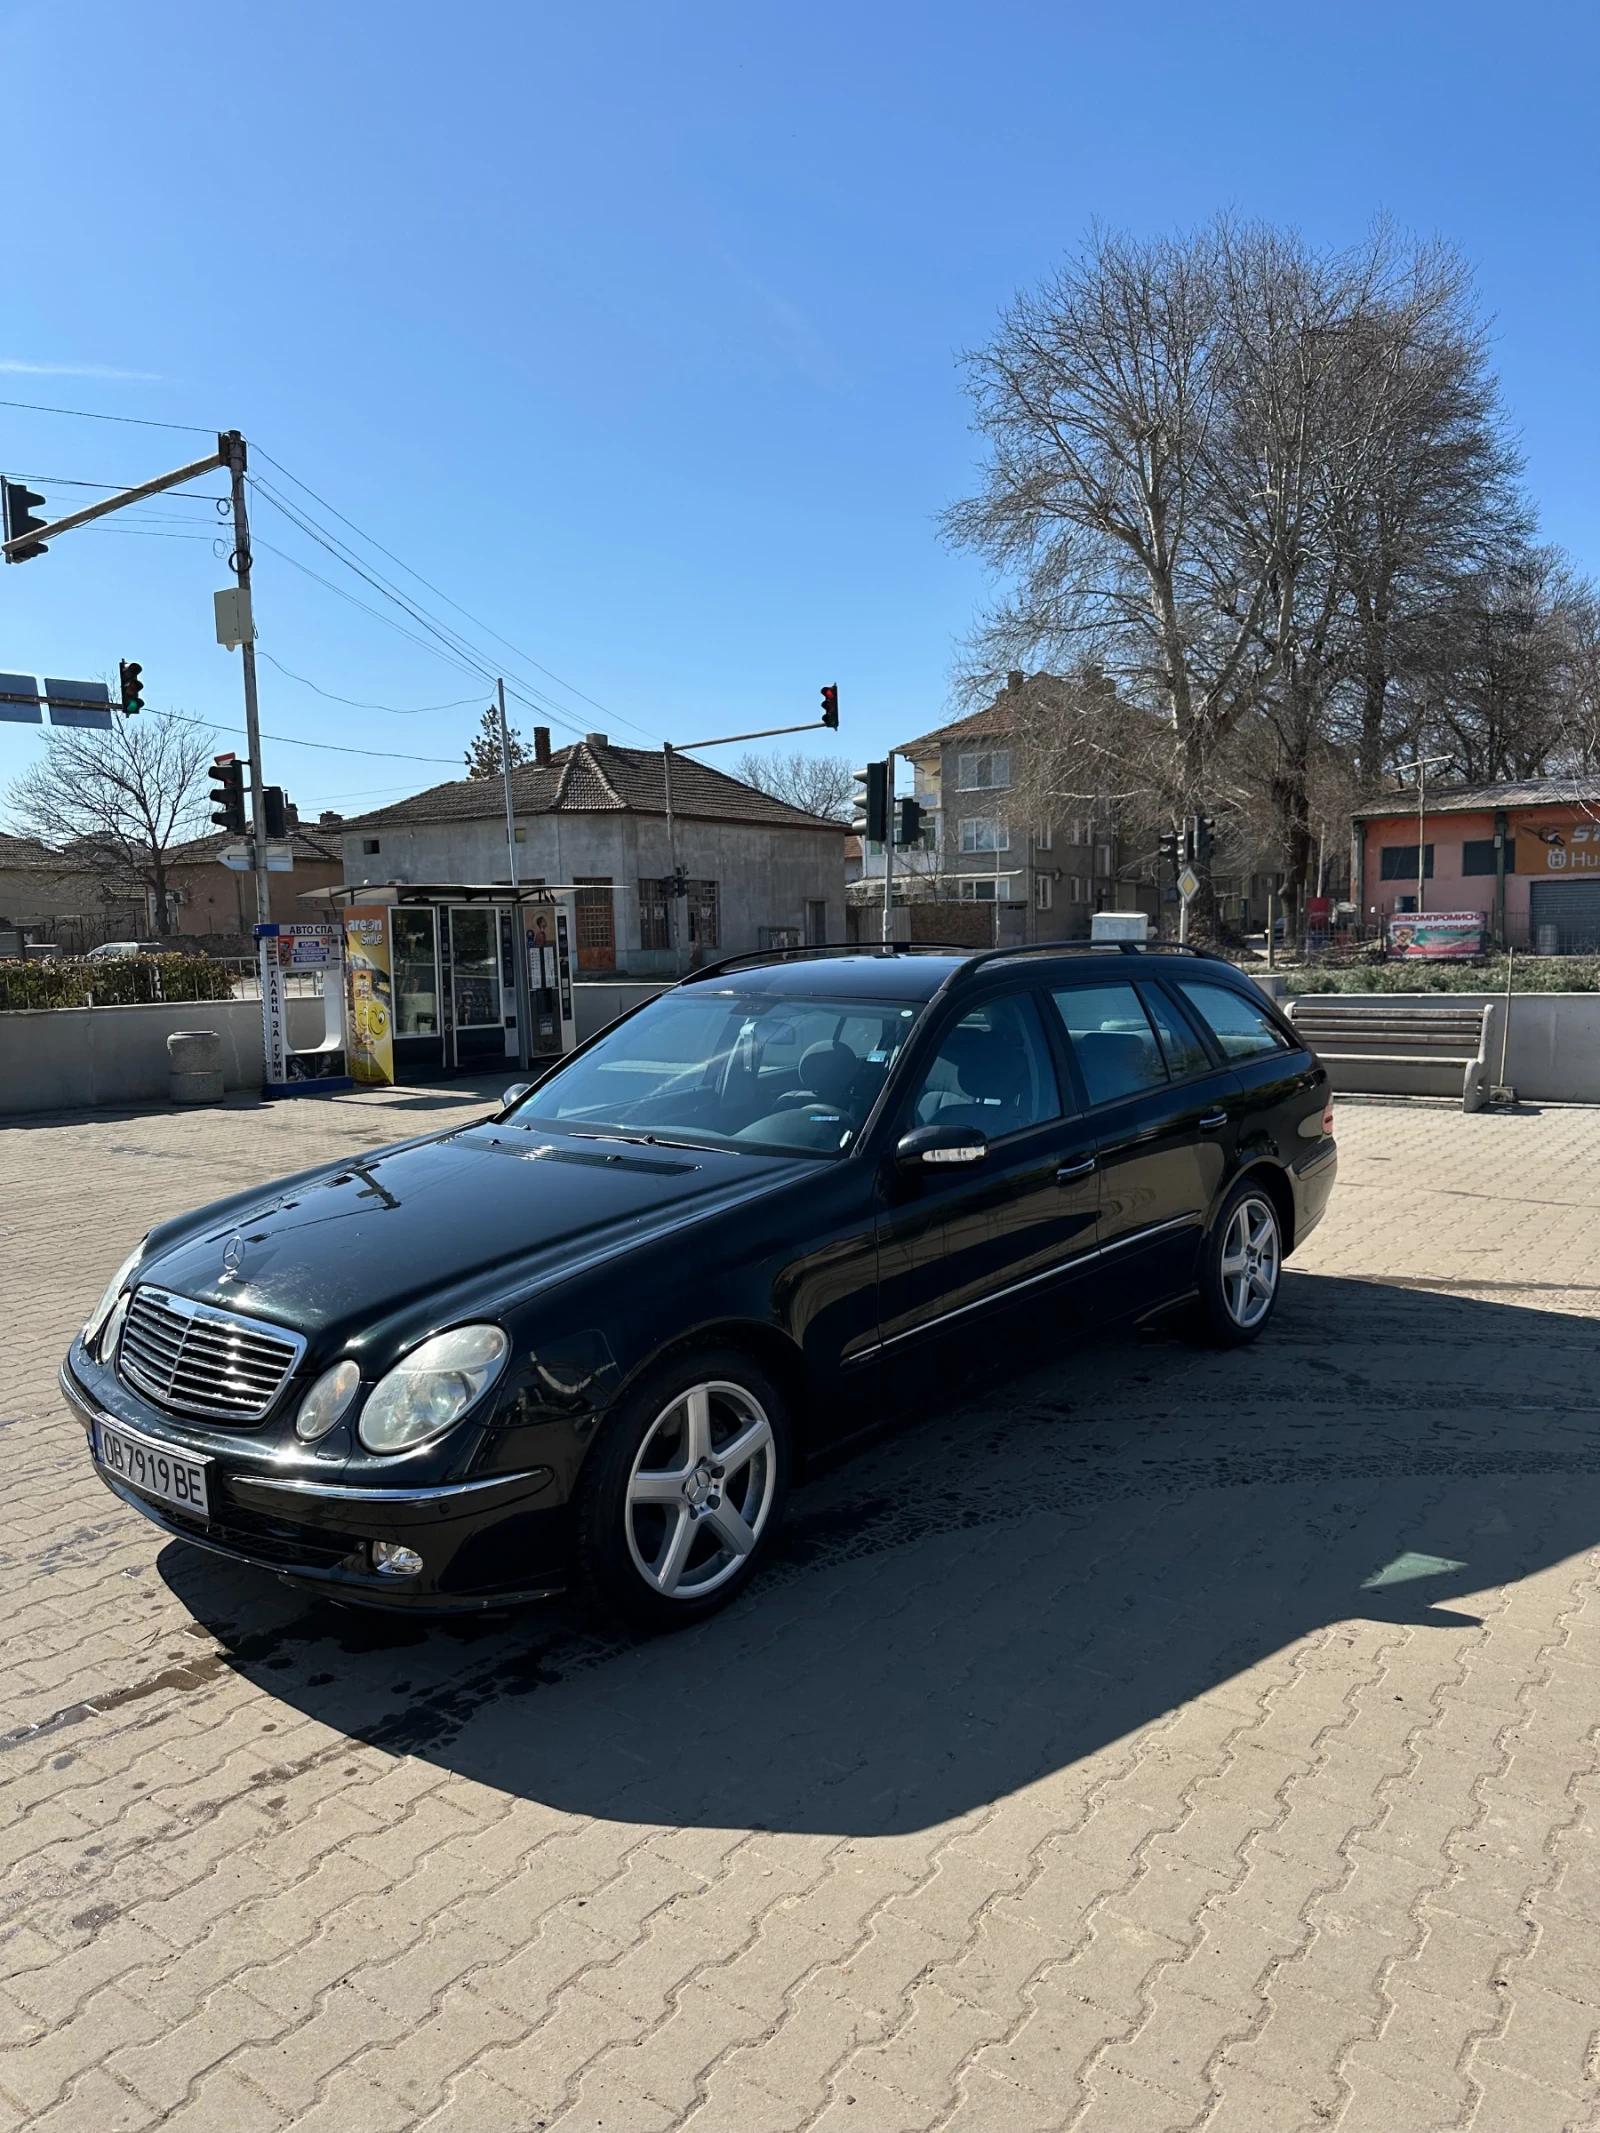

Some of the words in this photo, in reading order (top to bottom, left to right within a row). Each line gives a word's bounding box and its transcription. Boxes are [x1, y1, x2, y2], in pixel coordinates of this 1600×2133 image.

[1571, 852, 1600, 867] Hu
[289, 925, 314, 934] АВТО
[315, 925, 334, 934] СПА
[348, 919, 382, 932] areon
[270, 971, 279, 1014] ГЛАНЦ
[272, 1021, 280, 1037] ЗА
[273, 1044, 282, 1077] ГУМИ
